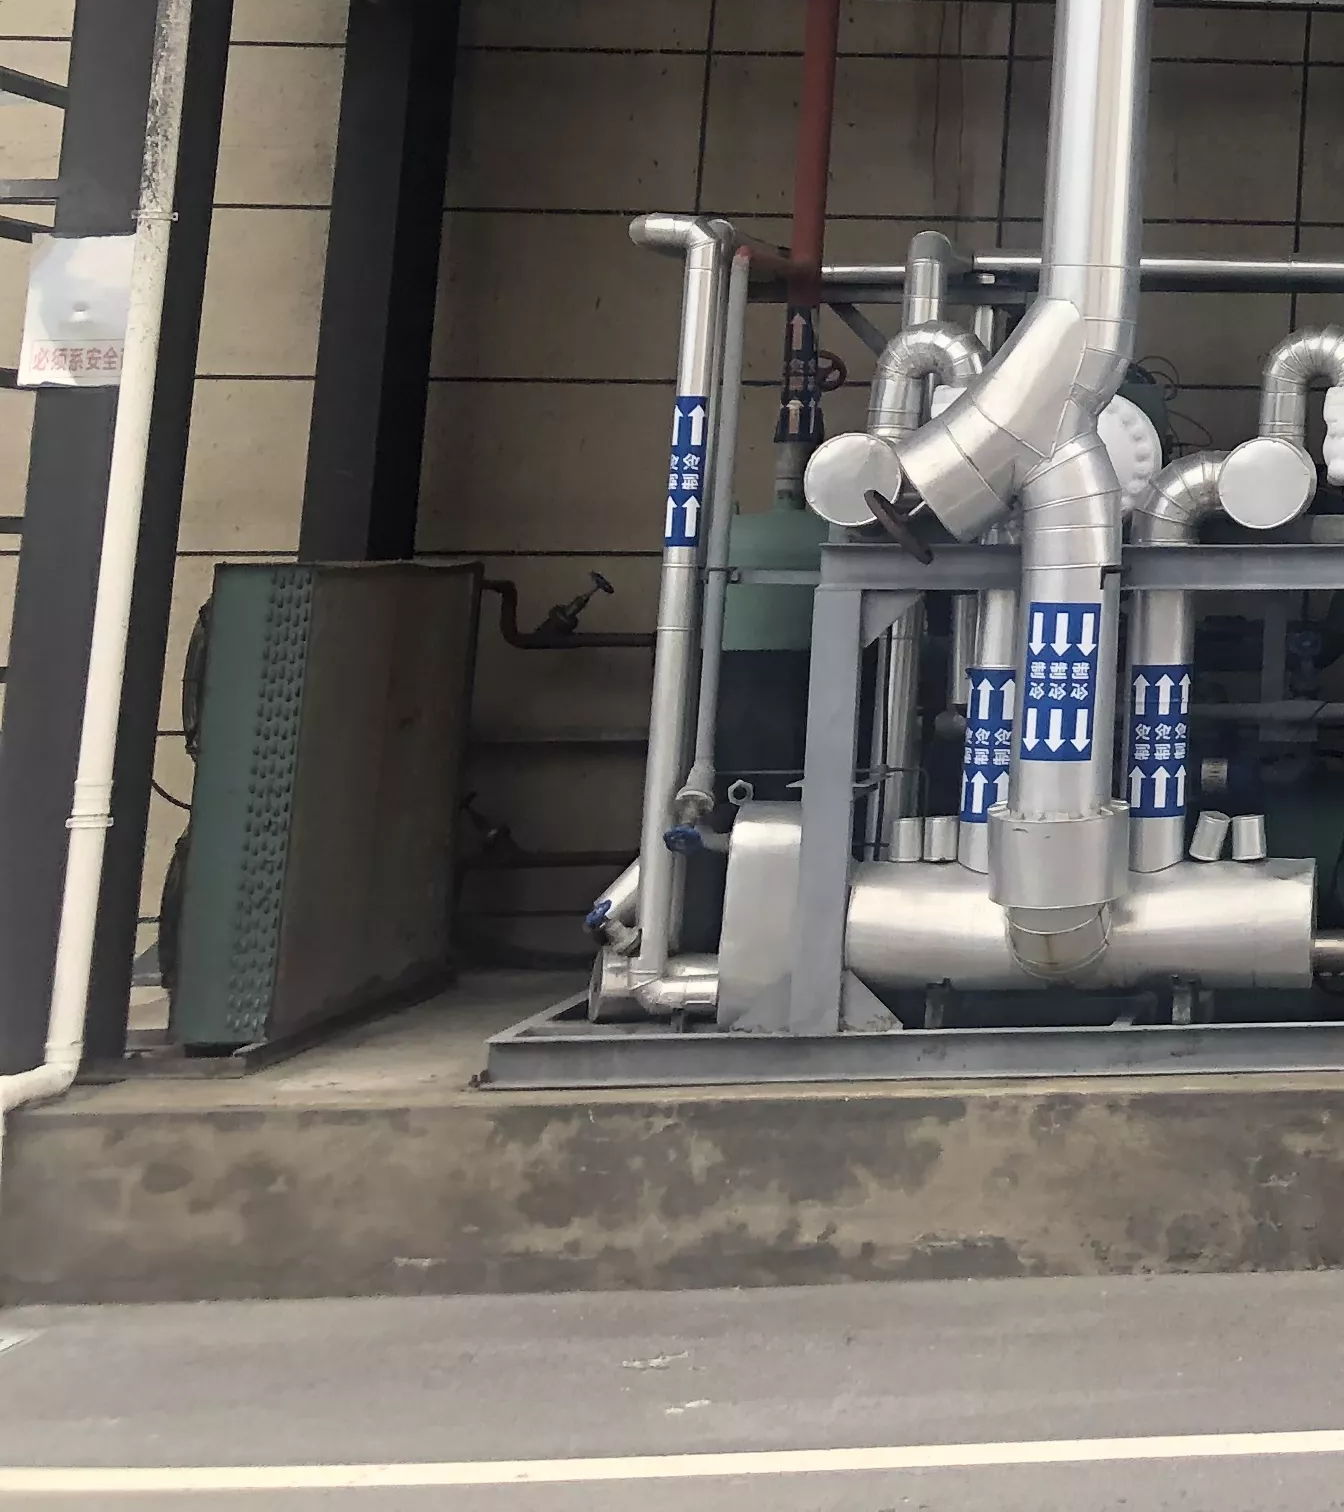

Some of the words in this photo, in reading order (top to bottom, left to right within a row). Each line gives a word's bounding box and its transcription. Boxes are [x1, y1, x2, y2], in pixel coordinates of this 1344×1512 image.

[32, 348, 124, 372] 必须系安全
[681, 452, 701, 491] 制冷
[1030, 661, 1046, 701] 制冷
[1048, 661, 1068, 701] 制冷
[1070, 661, 1091, 701] 制冷
[973, 727, 991, 766] 制冷
[992, 727, 1012, 766] 制冷
[1133, 722, 1151, 761] 制冷
[1153, 722, 1172, 761] 制冷
